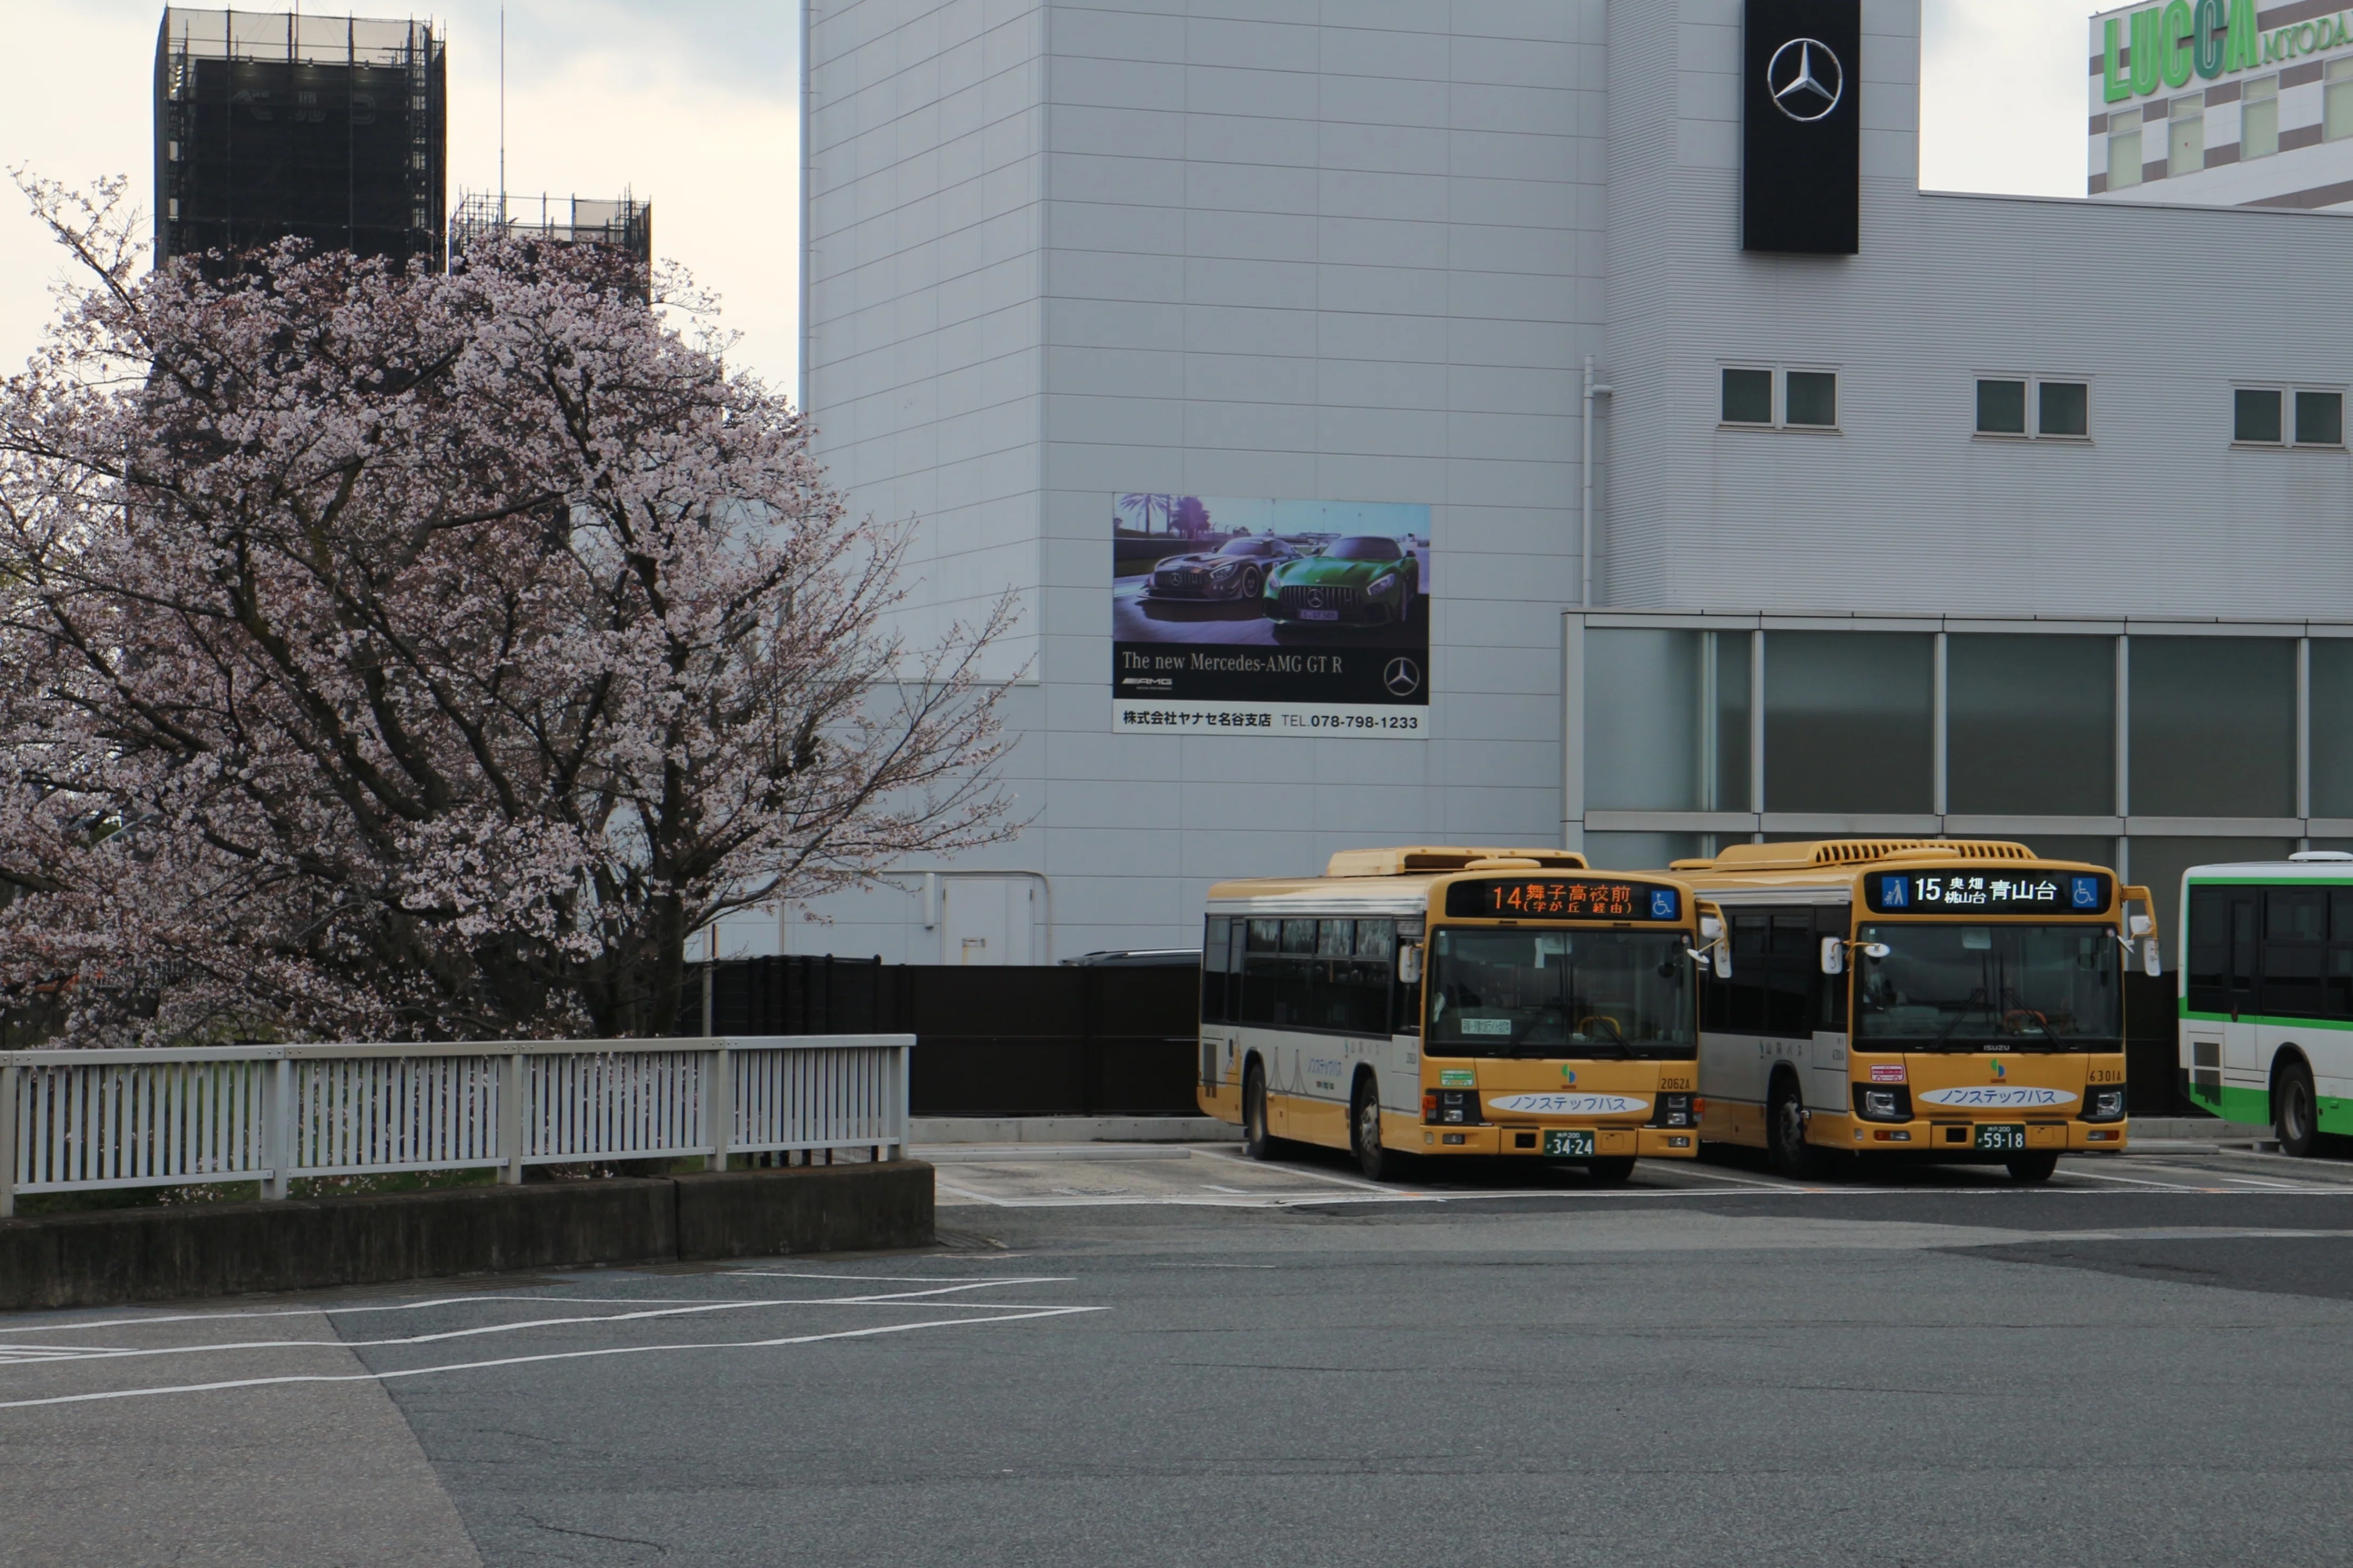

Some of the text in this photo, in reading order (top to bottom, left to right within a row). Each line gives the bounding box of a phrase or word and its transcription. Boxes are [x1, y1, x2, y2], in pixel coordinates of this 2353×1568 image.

[2262, 12, 2353, 64] MYODA
[2104, 0, 2261, 103] LUCCA
[1123, 651, 1343, 673] The new Mercedes-AMG GT R
[1124, 710, 1272, 727] 株式会社ヤナセ名谷支店
[1494, 883, 1631, 909] 14 舞子高校前
[1915, 878, 1941, 901] 15
[1989, 880, 2058, 901] 青山台
[1944, 890, 1987, 904] 桃山台
[1661, 1078, 1691, 1090] 2062A
[2089, 1070, 2121, 1082] 6301A
[1510, 1096, 1627, 1111] ノンステップバス
[1939, 1089, 2056, 1104] ノンステップバス
[1552, 1138, 1593, 1155] 34-24
[1983, 1133, 2024, 1149] 59-18
